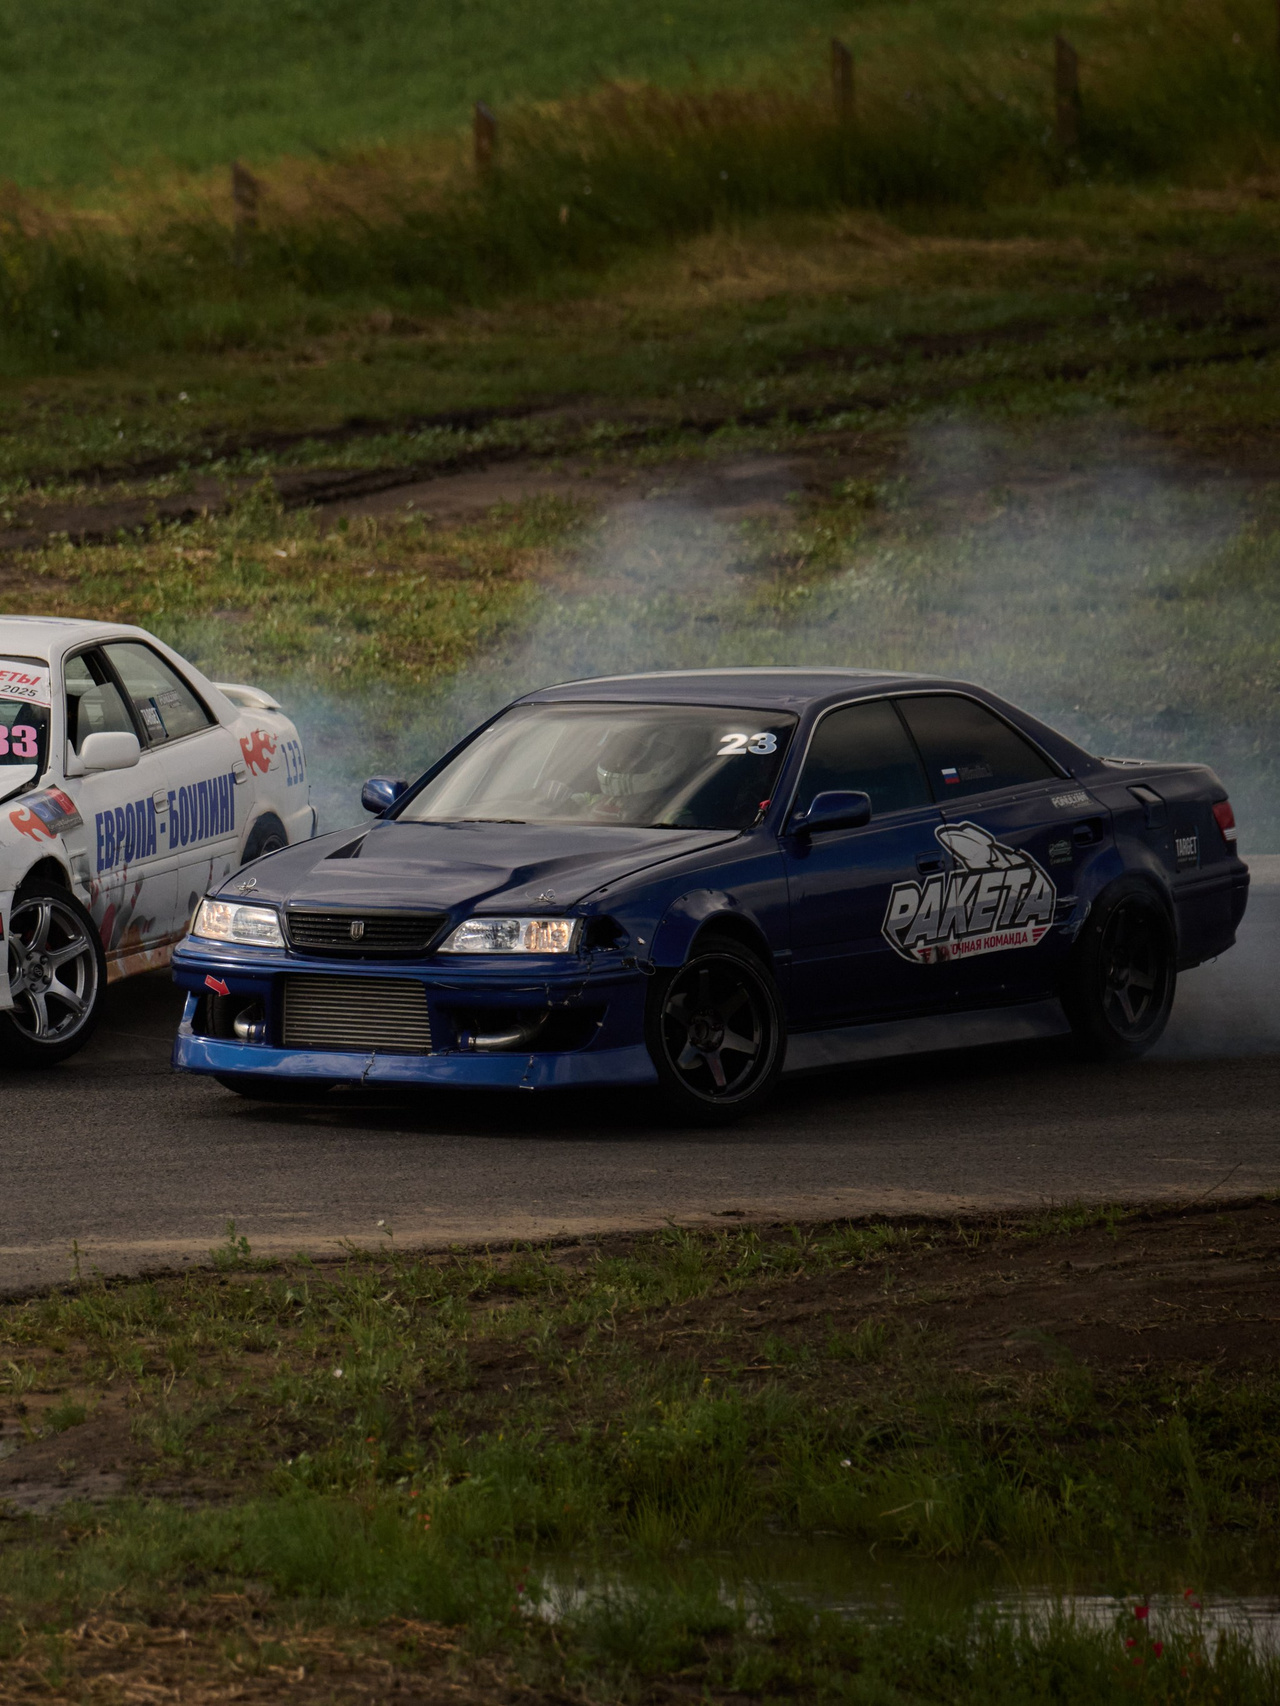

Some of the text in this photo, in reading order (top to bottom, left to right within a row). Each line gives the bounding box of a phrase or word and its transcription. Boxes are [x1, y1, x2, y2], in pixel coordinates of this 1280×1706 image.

[1, 684, 38, 698] 2025
[717, 732, 778, 756] 23
[280, 740, 304, 787] 133
[984, 931, 1028, 948] КОМАНДА
